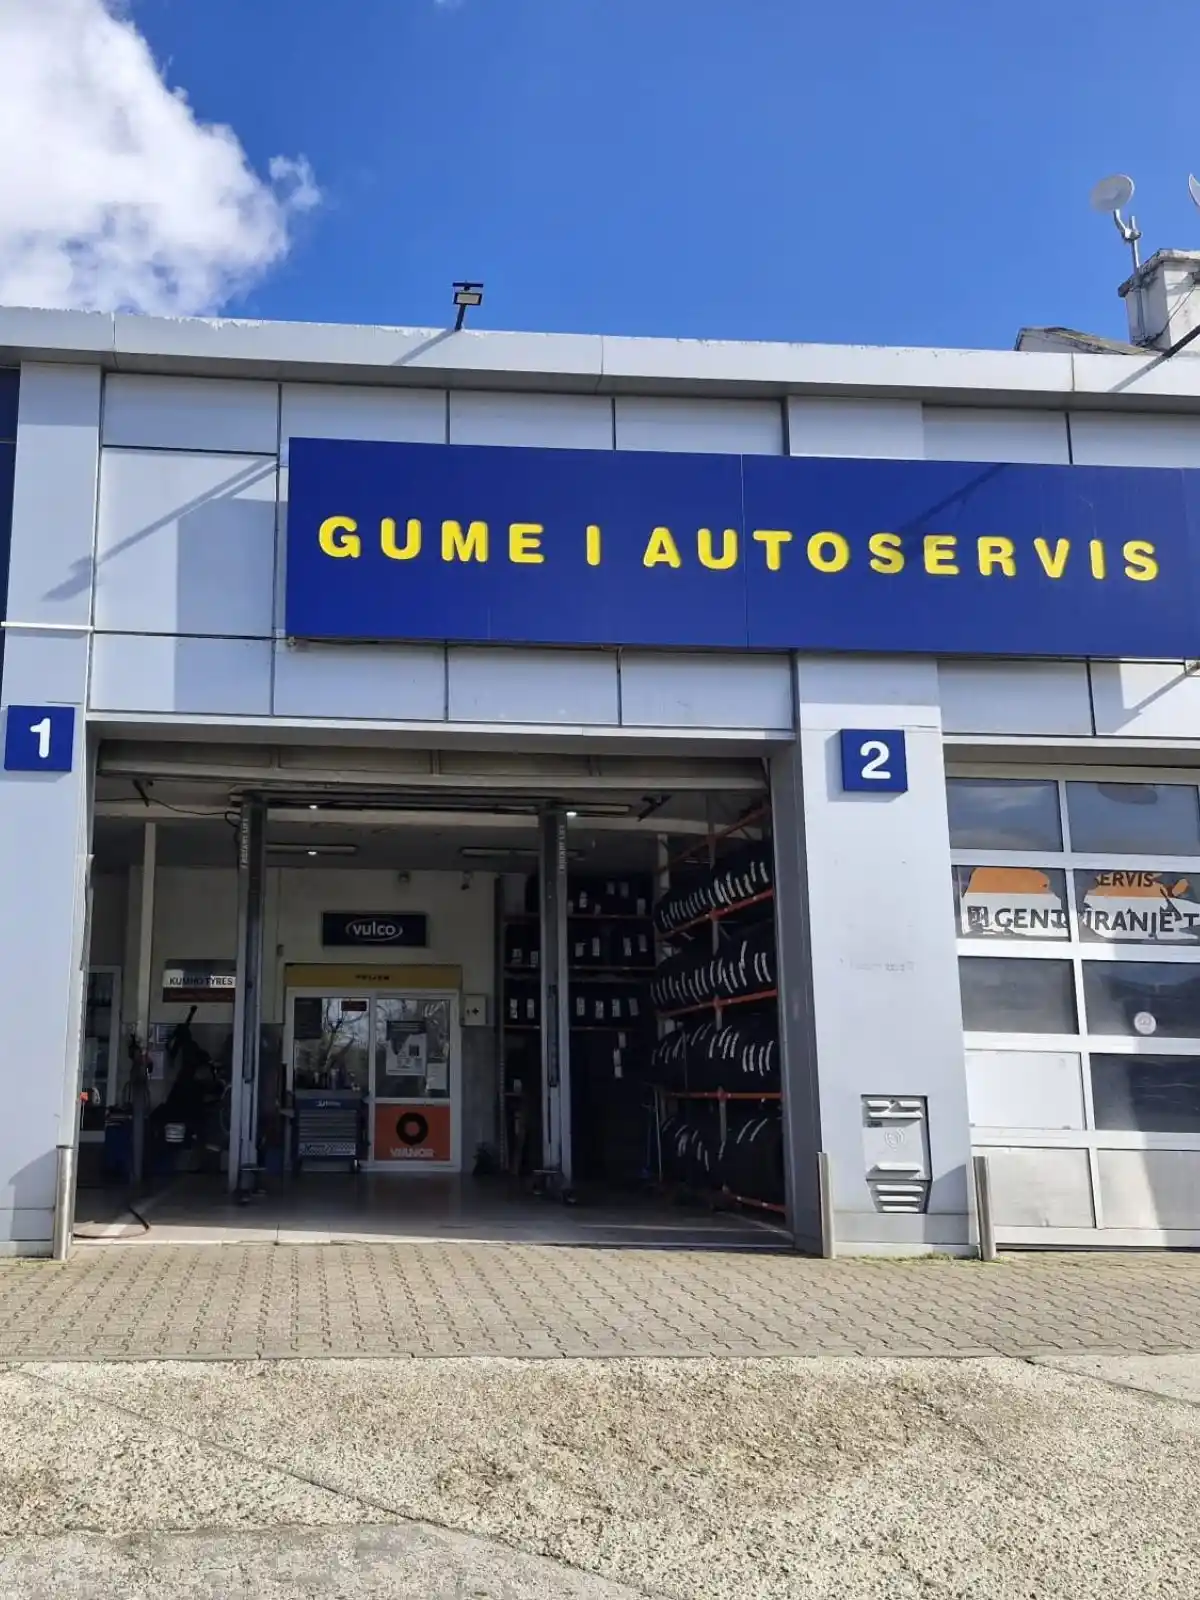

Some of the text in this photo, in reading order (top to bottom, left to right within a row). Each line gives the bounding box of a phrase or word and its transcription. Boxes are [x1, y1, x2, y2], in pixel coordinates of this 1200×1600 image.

[318, 516, 1159, 580] GUME I AUTOSERVIS
[29, 717, 51, 760] 1
[860, 740, 892, 780] 2
[1096, 871, 1154, 888] ERVIS
[352, 920, 397, 936] vulco
[204, 977, 233, 986] TYRES
